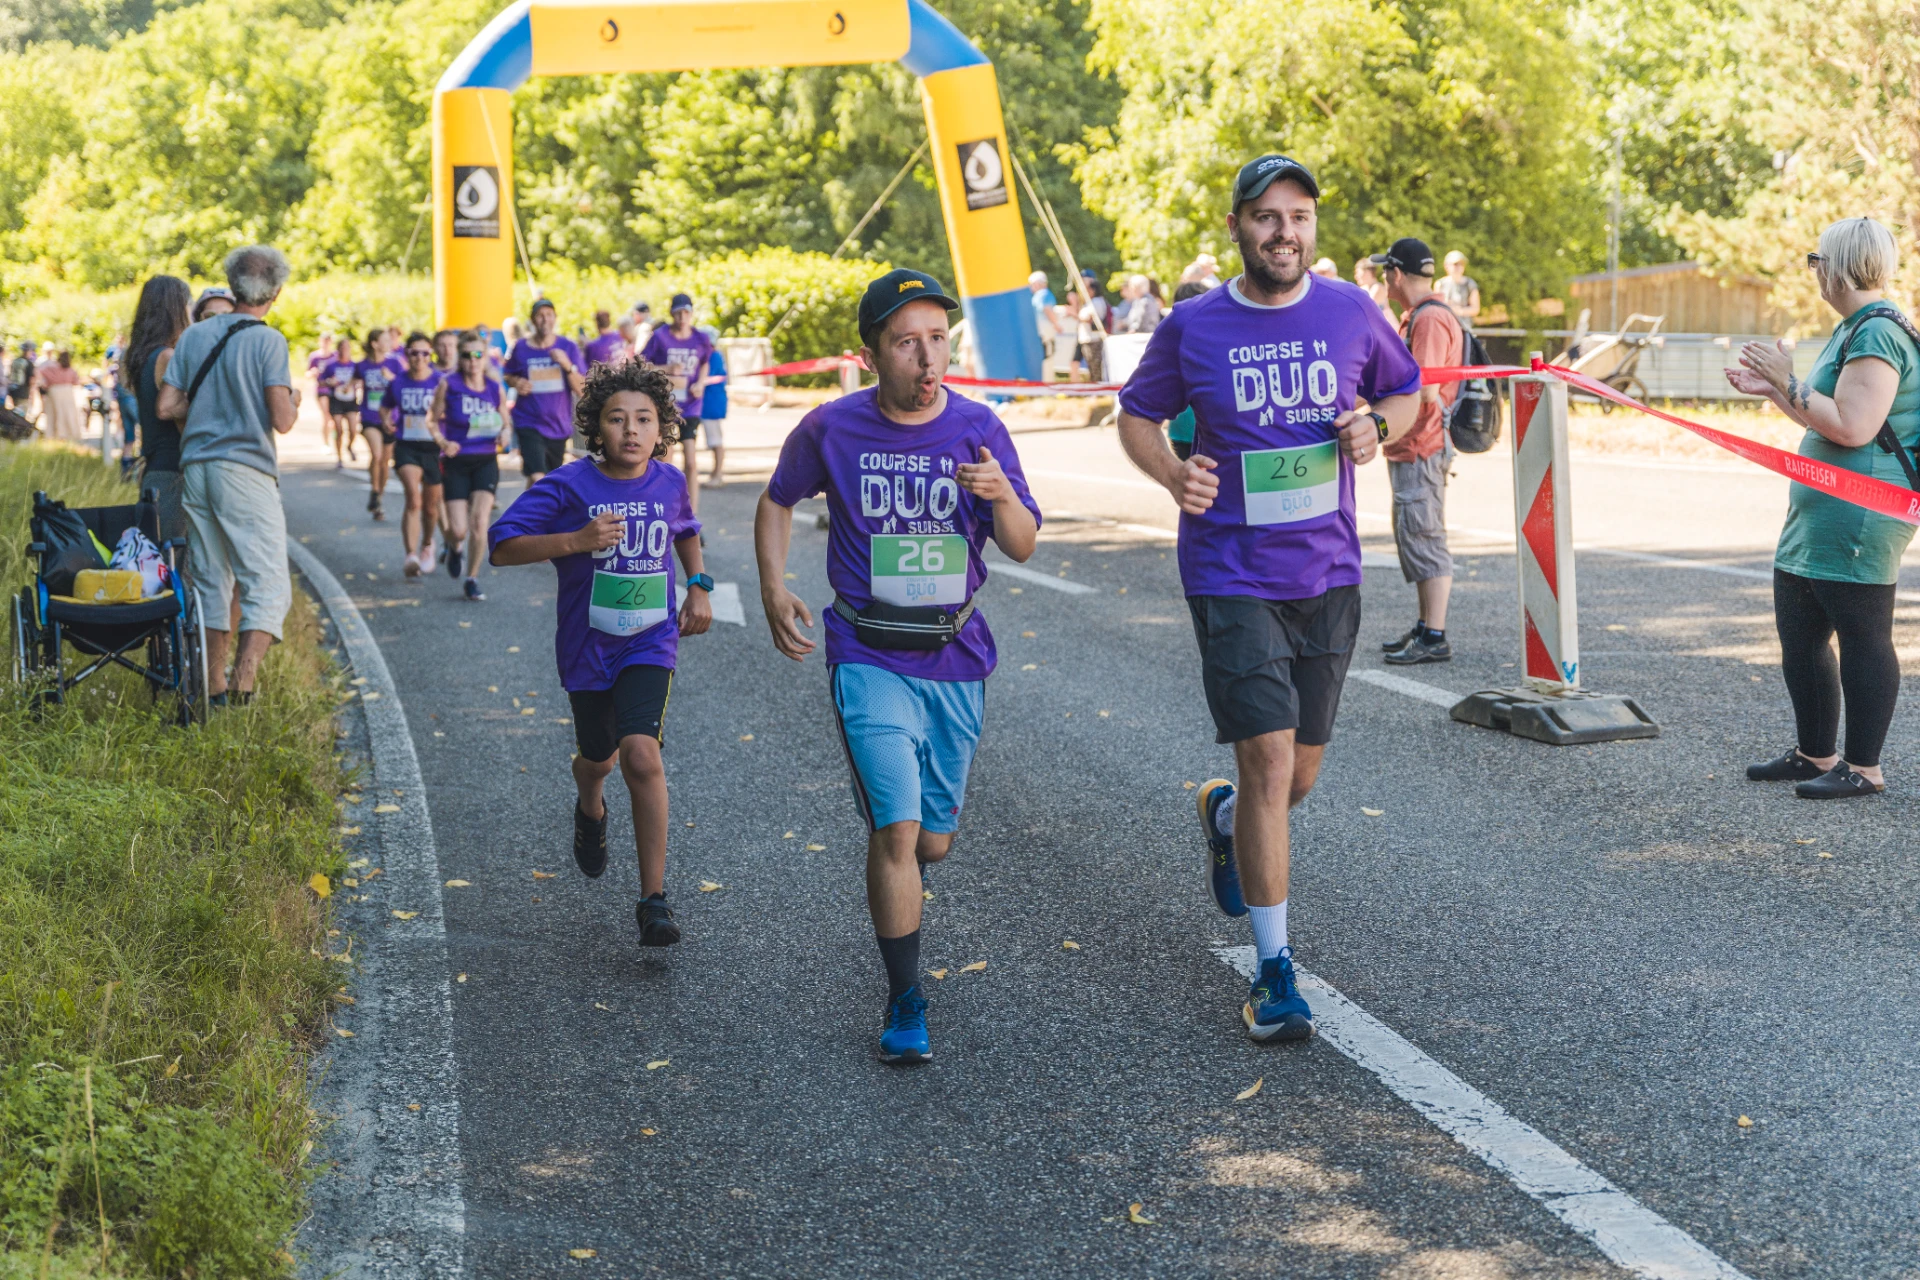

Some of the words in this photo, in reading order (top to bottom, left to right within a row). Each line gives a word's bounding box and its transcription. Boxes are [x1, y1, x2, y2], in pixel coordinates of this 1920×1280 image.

[1229, 341, 1303, 364] COURSE
[1232, 360, 1338, 412] DUO
[1285, 407, 1337, 425] SUISSE
[860, 453, 930, 472] COURSE
[1270, 454, 1308, 480] 26
[1784, 456, 1837, 488] RAIFFEISEN
[861, 475, 958, 520] DUO
[1282, 495, 1312, 511] DUO
[588, 502, 648, 519] COURSE
[908, 520, 956, 535] SUISSE
[592, 520, 669, 558] UO
[626, 558, 664, 572] SUISSE
[898, 540, 945, 572] 26
[615, 580, 646, 606] 26
[906, 583, 936, 596] DUO
[617, 616, 643, 628] DUO
